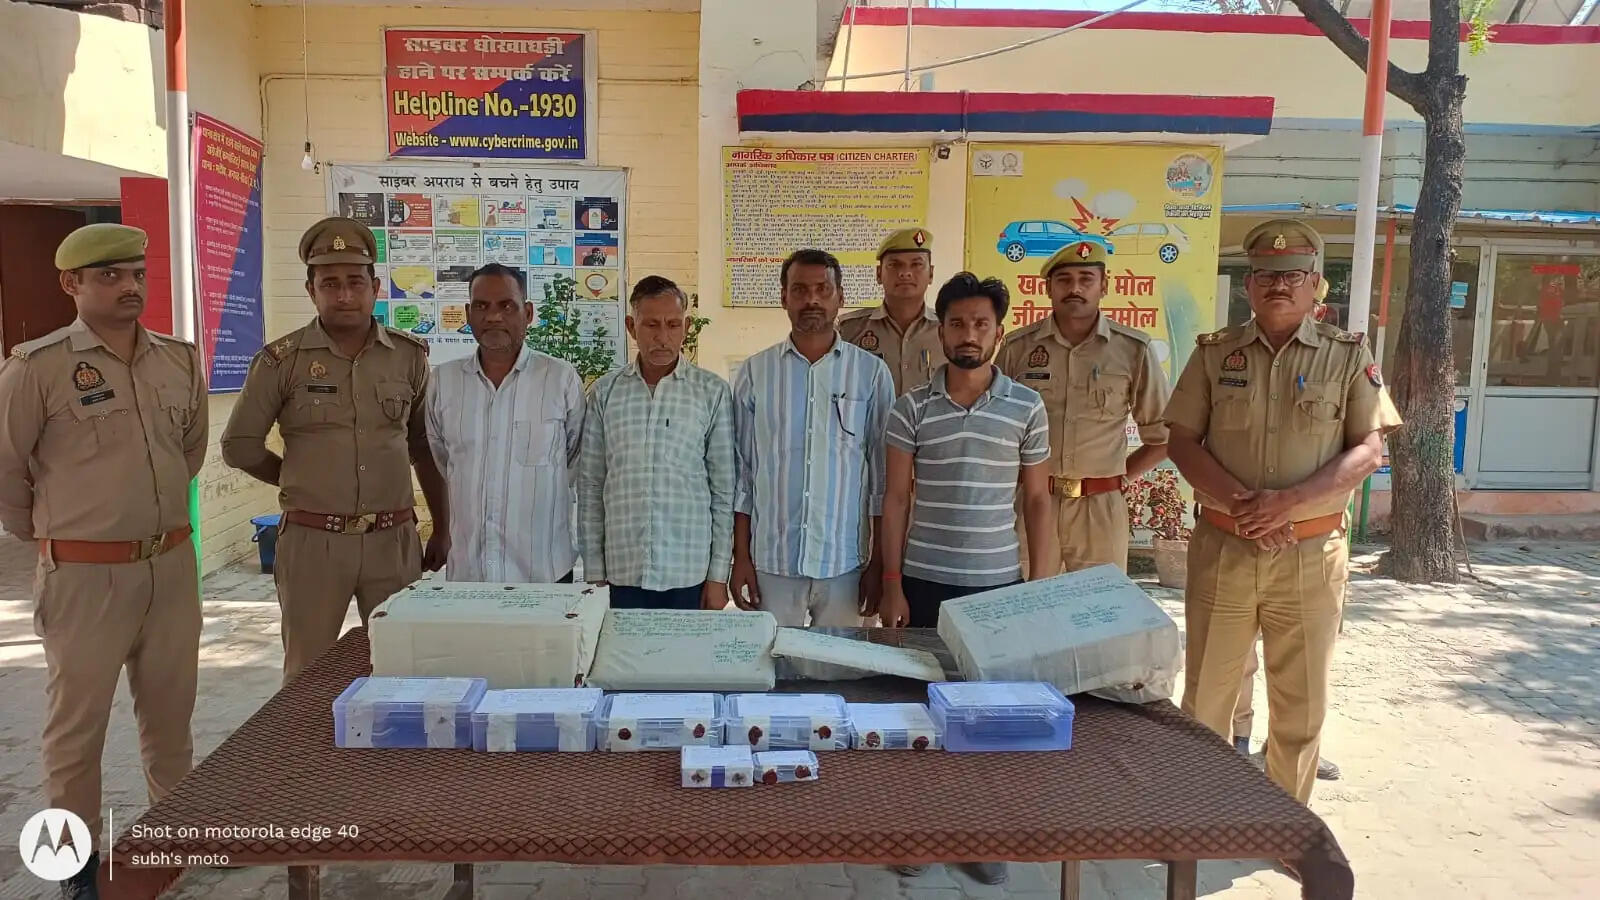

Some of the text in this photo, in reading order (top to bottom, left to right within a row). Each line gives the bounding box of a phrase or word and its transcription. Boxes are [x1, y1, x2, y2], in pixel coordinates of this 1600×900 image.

[440, 66, 468, 80] पर
[470, 63, 534, 81] सम्पर्क
[537, 63, 573, 82] करें
[394, 91, 577, 121] Helpline No.-1930
[395, 132, 439, 147] Website
[449, 134, 579, 152] www.cybercrime.gov.in
[732, 149, 917, 161] नागरिक अधिकार पत्र (CITIZEN CHARTER)
[378, 173, 580, 194] साइबर अपराध से बचने हेतु उपाय
[1114, 268, 1156, 296] मोल
